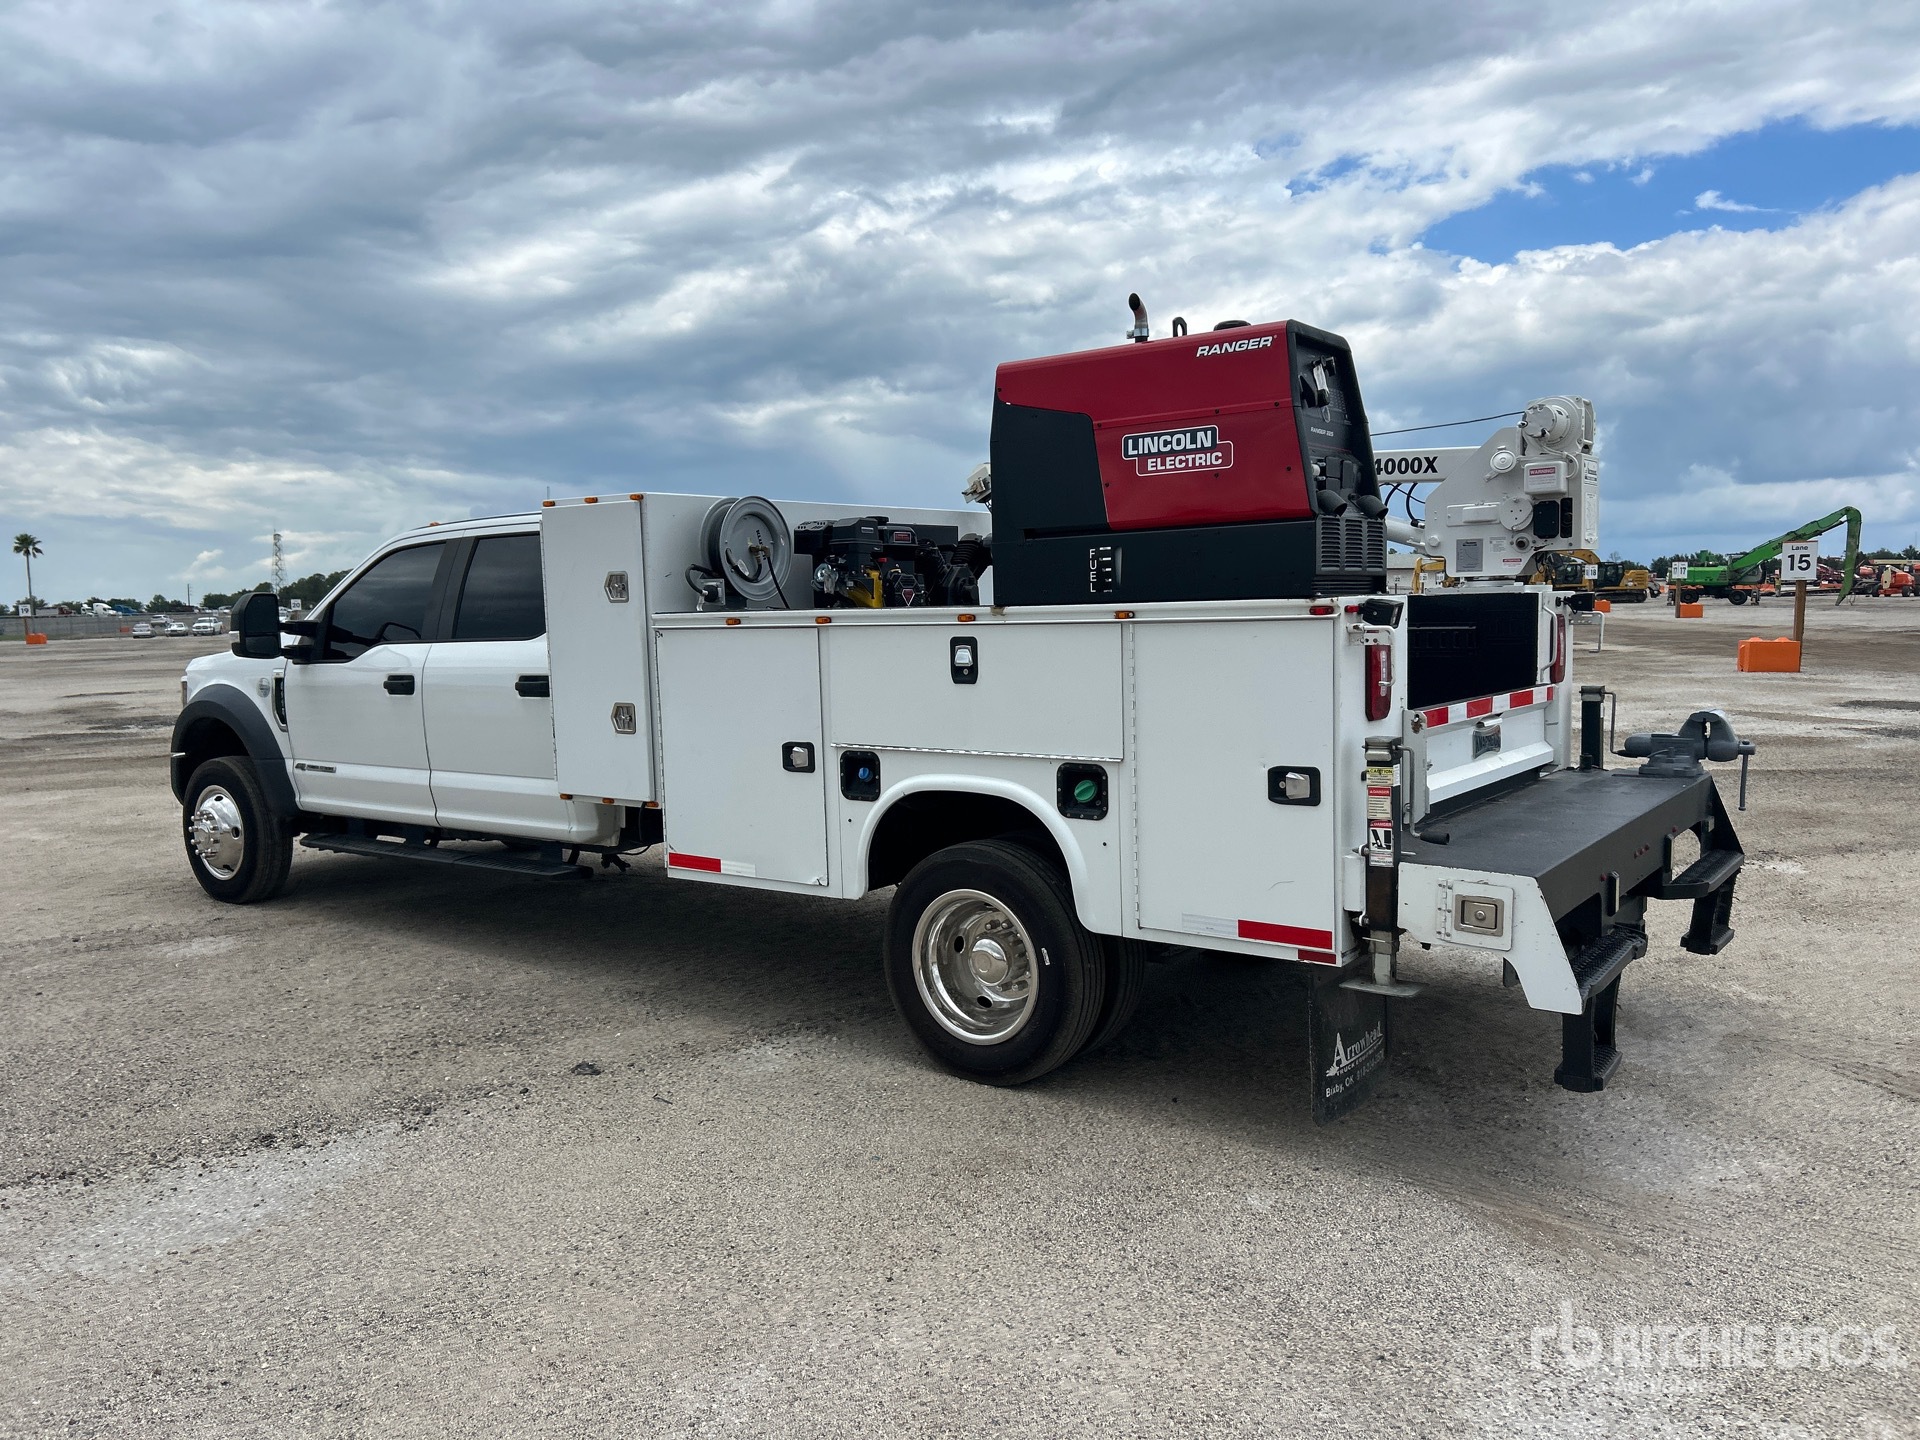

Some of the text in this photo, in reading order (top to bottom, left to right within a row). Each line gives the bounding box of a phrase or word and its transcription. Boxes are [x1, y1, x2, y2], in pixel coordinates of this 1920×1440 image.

[1196, 336, 1273, 357] RANGER
[1128, 430, 1212, 456] LINCOLN
[1147, 452, 1223, 471] ELECTRIC
[1374, 456, 1438, 475] 4000X
[1089, 548, 1097, 592] FUEL
[1787, 553, 1811, 571] 15
[1332, 1021, 1383, 1068] Arrowhead
